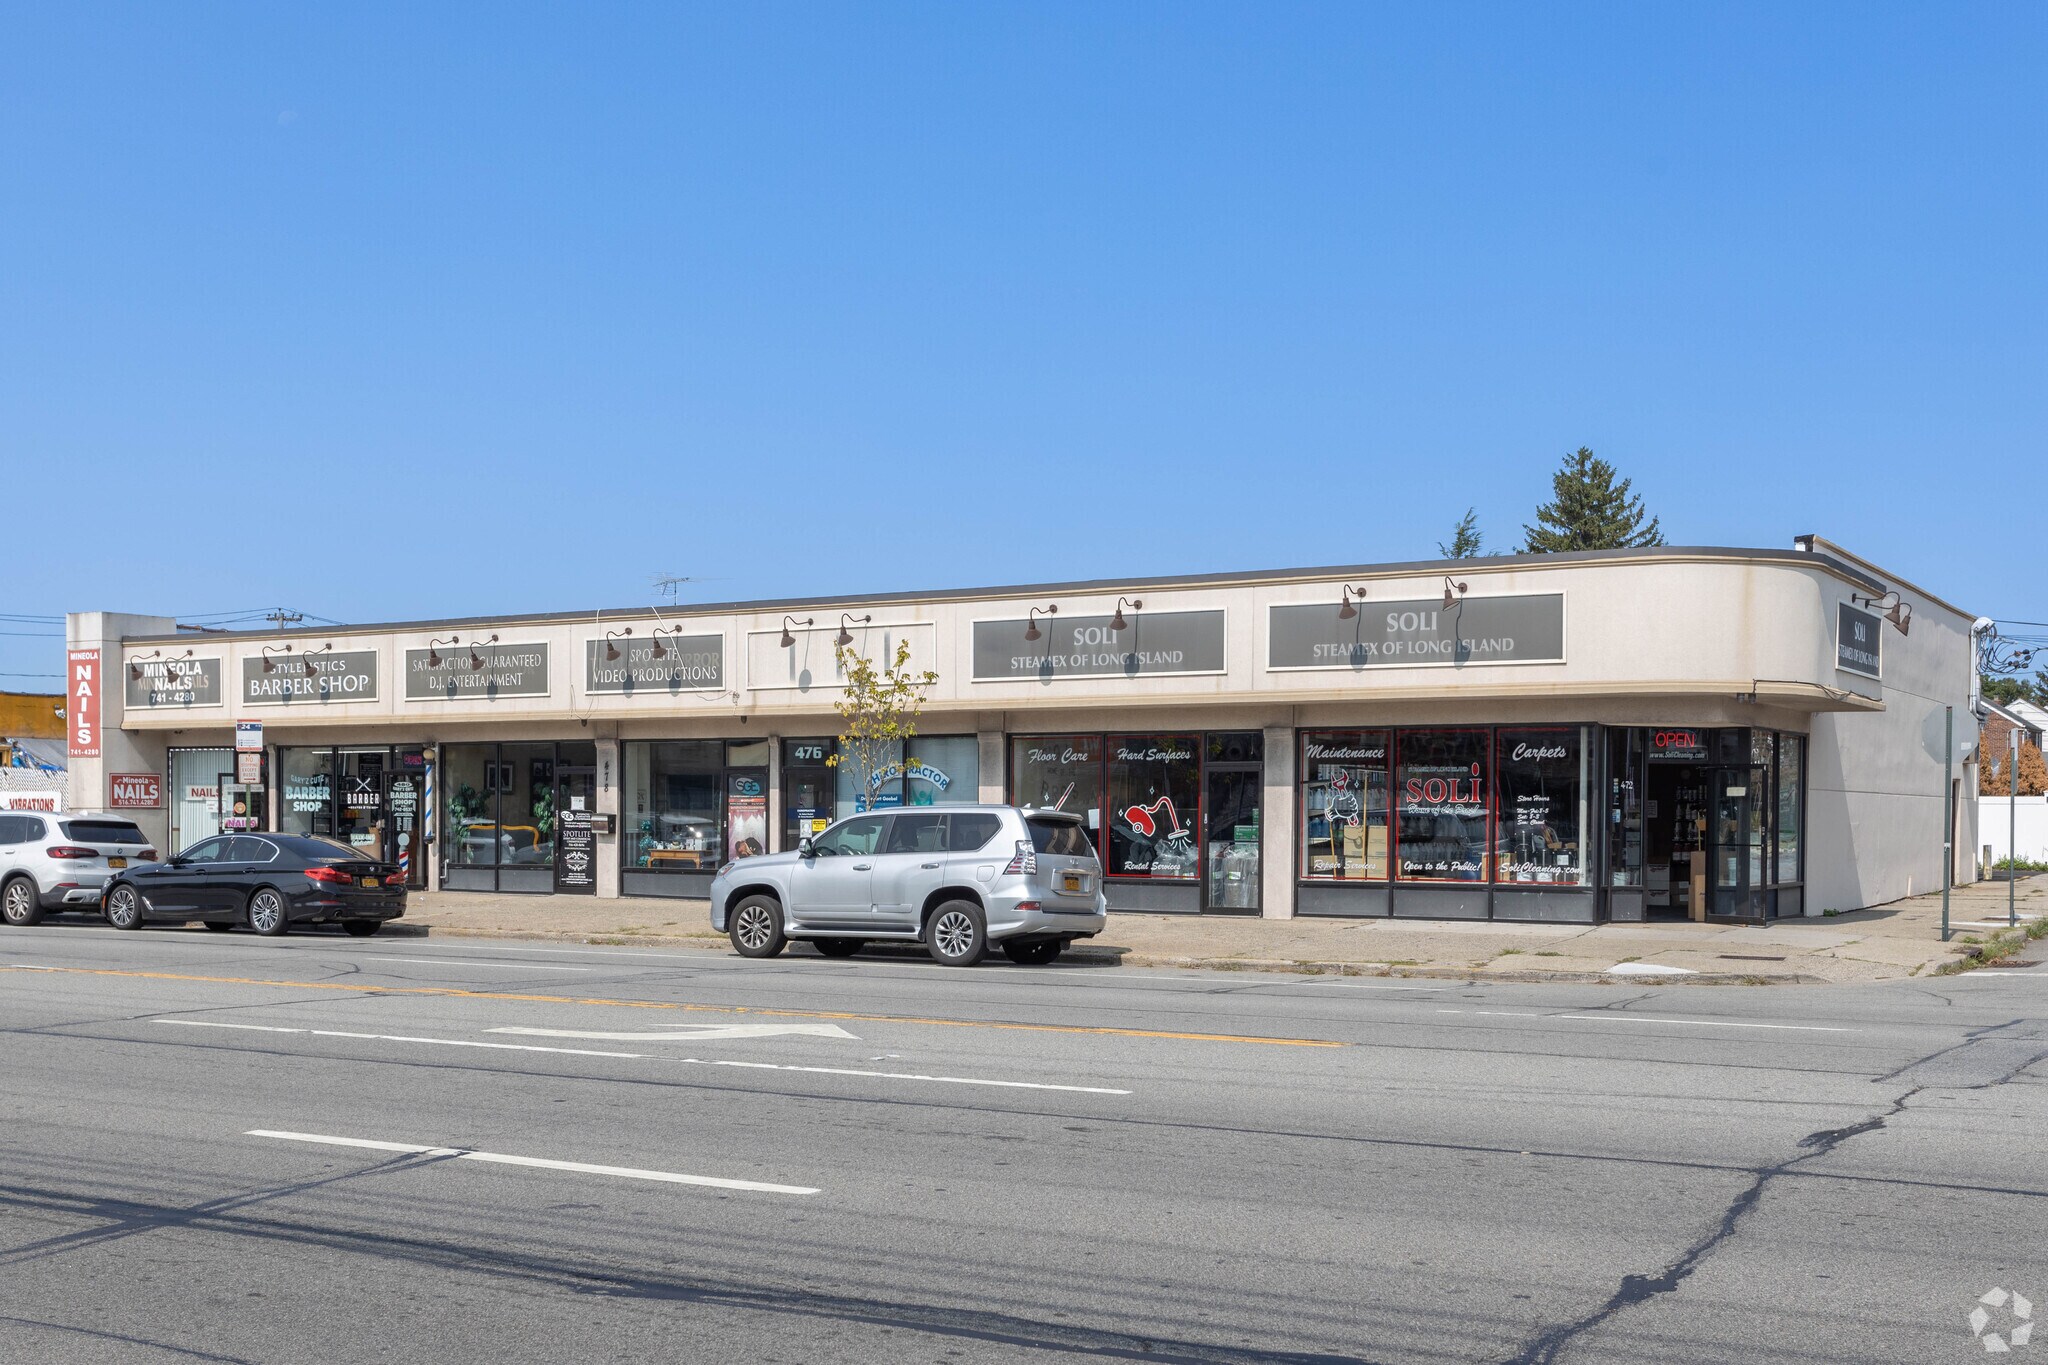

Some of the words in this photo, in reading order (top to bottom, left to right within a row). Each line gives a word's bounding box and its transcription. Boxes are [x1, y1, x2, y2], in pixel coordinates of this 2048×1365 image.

[1387, 612, 1437, 632] SOLI
[1074, 628, 1118, 646] SOLI
[1854, 621, 1866, 642] SOLI
[1313, 642, 1378, 657] STEAMEX
[1382, 641, 1404, 655] OF
[1408, 640, 1452, 654] LONG
[1457, 638, 1514, 652] ISLAND
[70, 652, 98, 660] MINEOLA
[1011, 654, 1067, 669] STEAMEX
[1070, 654, 1088, 667] OF
[1092, 652, 1130, 666] LONG
[1136, 650, 1183, 664] ISLAND
[144, 662, 202, 677] MINEOLA
[594, 669, 628, 683] VIDEO
[632, 666, 717, 682] PRODUCTIONS
[250, 678, 314, 696] BARBER
[318, 675, 368, 693] SHOP
[430, 676, 444, 690] D.J.
[448, 673, 522, 688] ENTERTAINMENT
[76, 665, 92, 745] NAILS
[152, 693, 166, 703] 741
[174, 692, 195, 702] 4280
[1655, 732, 1695, 747] OPEN
[795, 746, 822, 759] 476
[1028, 749, 1056, 764] Floor
[1061, 748, 1088, 764] Care
[1117, 748, 1146, 761] Hard
[1146, 748, 1191, 764] Surfaces
[1306, 744, 1384, 759] Maintenance
[1512, 742, 1567, 762] Carpets
[113, 785, 158, 799] NAILS
[1620, 780, 1634, 789] 472
[286, 786, 330, 800] BARBER
[348, 793, 380, 804] BARBER
[9, 798, 55, 812] VIBRATIONS
[293, 801, 322, 812] SHOP
[227, 819, 256, 828] NAIS
[1124, 861, 1149, 870] Rental
[1150, 861, 1181, 870] Services
[1314, 860, 1341, 870] Repair
[1344, 860, 1376, 870] Services
[1403, 861, 1423, 872] Open
[1425, 861, 1433, 870] to
[1436, 861, 1448, 870] the
[1450, 861, 1482, 872] Public!
[1500, 862, 1582, 876] SoliCleaning.com
